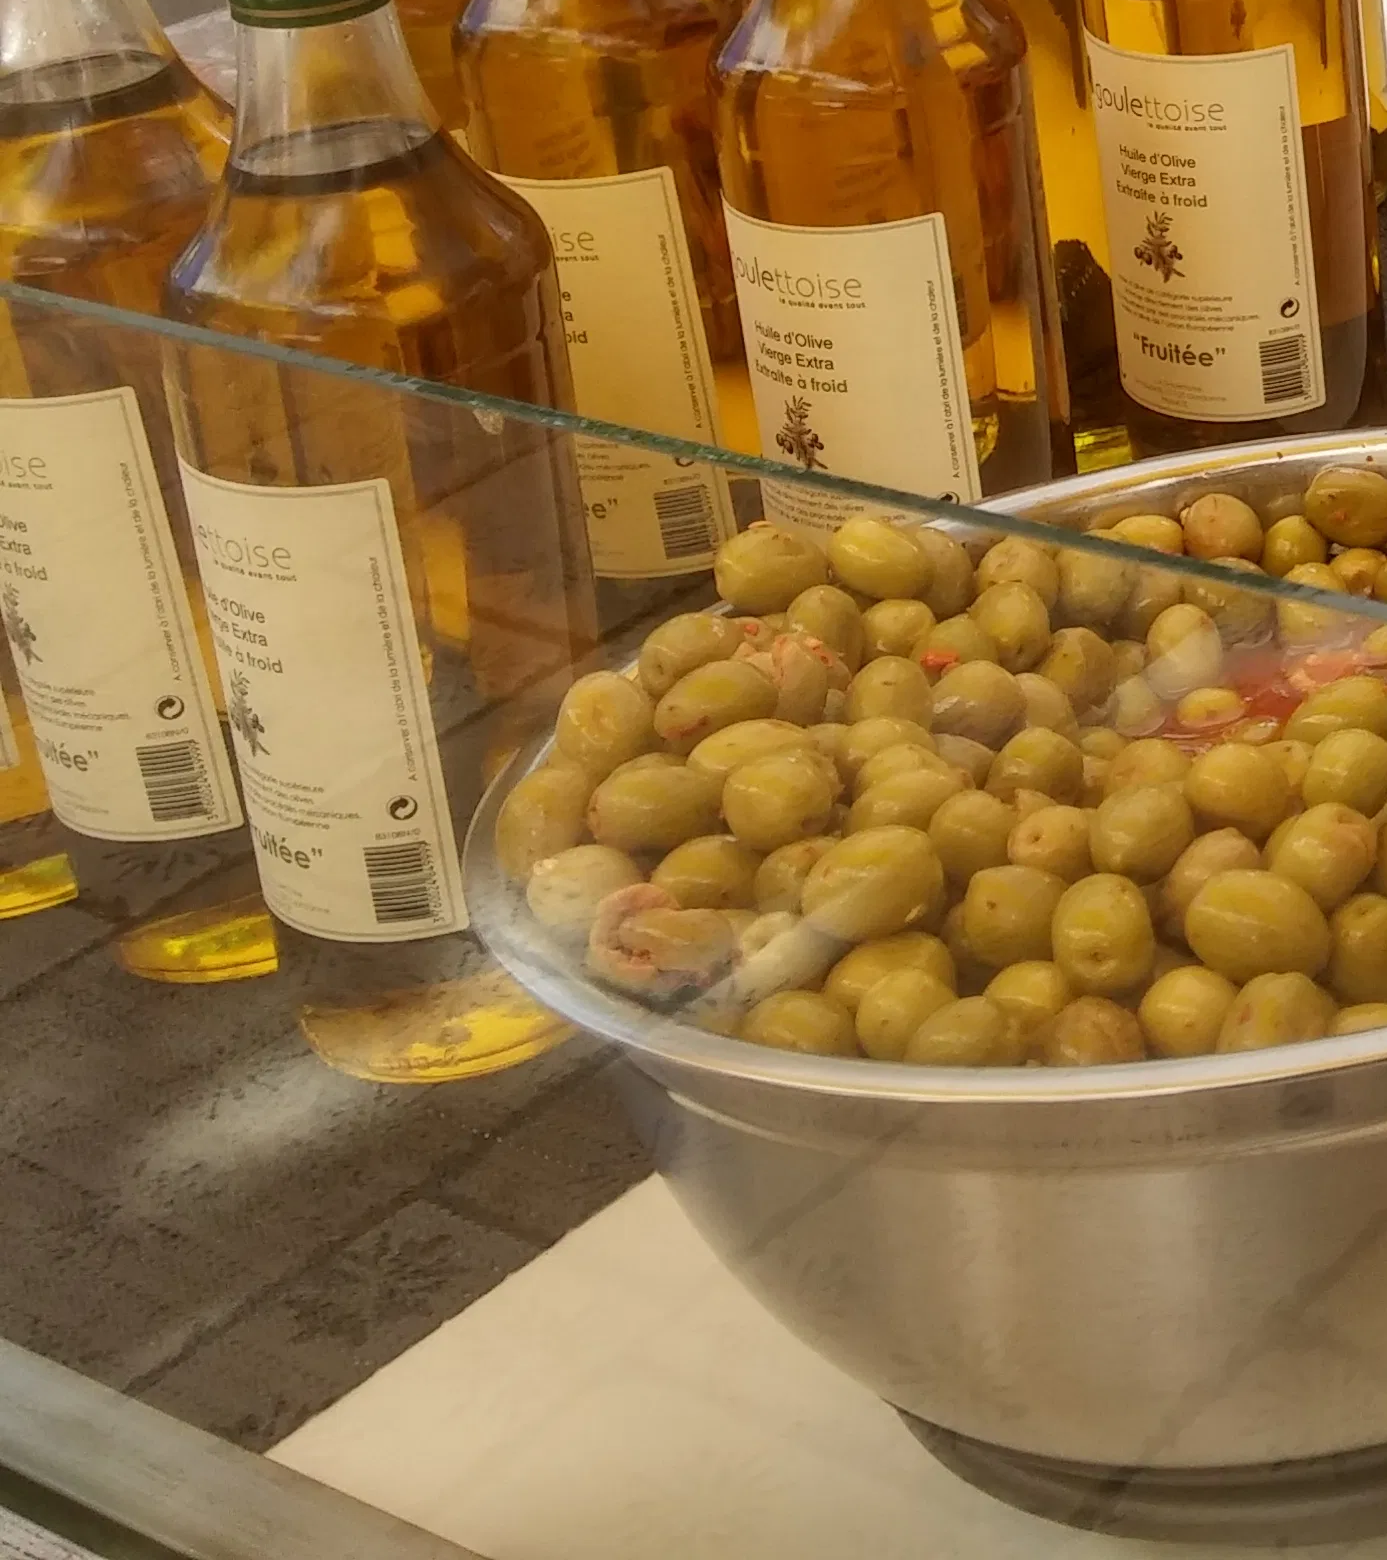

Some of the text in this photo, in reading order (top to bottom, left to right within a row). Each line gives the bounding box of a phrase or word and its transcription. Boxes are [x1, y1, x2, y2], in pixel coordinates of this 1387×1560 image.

[1095, 83, 1225, 122] goulettoise
[1119, 144, 1196, 169] Huile d'Olive
[1121, 162, 1196, 188] Vierge Extra
[1116, 179, 1208, 208] Extraite à froid
[846, 301, 866, 309] tout
[754, 319, 834, 350] Huile d'Olive
[757, 340, 835, 371] Vierge Extra
[1133, 331, 1226, 368] "Fruitée"
[797, 374, 807, 390] à
[810, 377, 848, 393] froid
[197, 524, 291, 570] ettoise
[231, 622, 269, 648] Extra
[247, 651, 284, 675] froid
